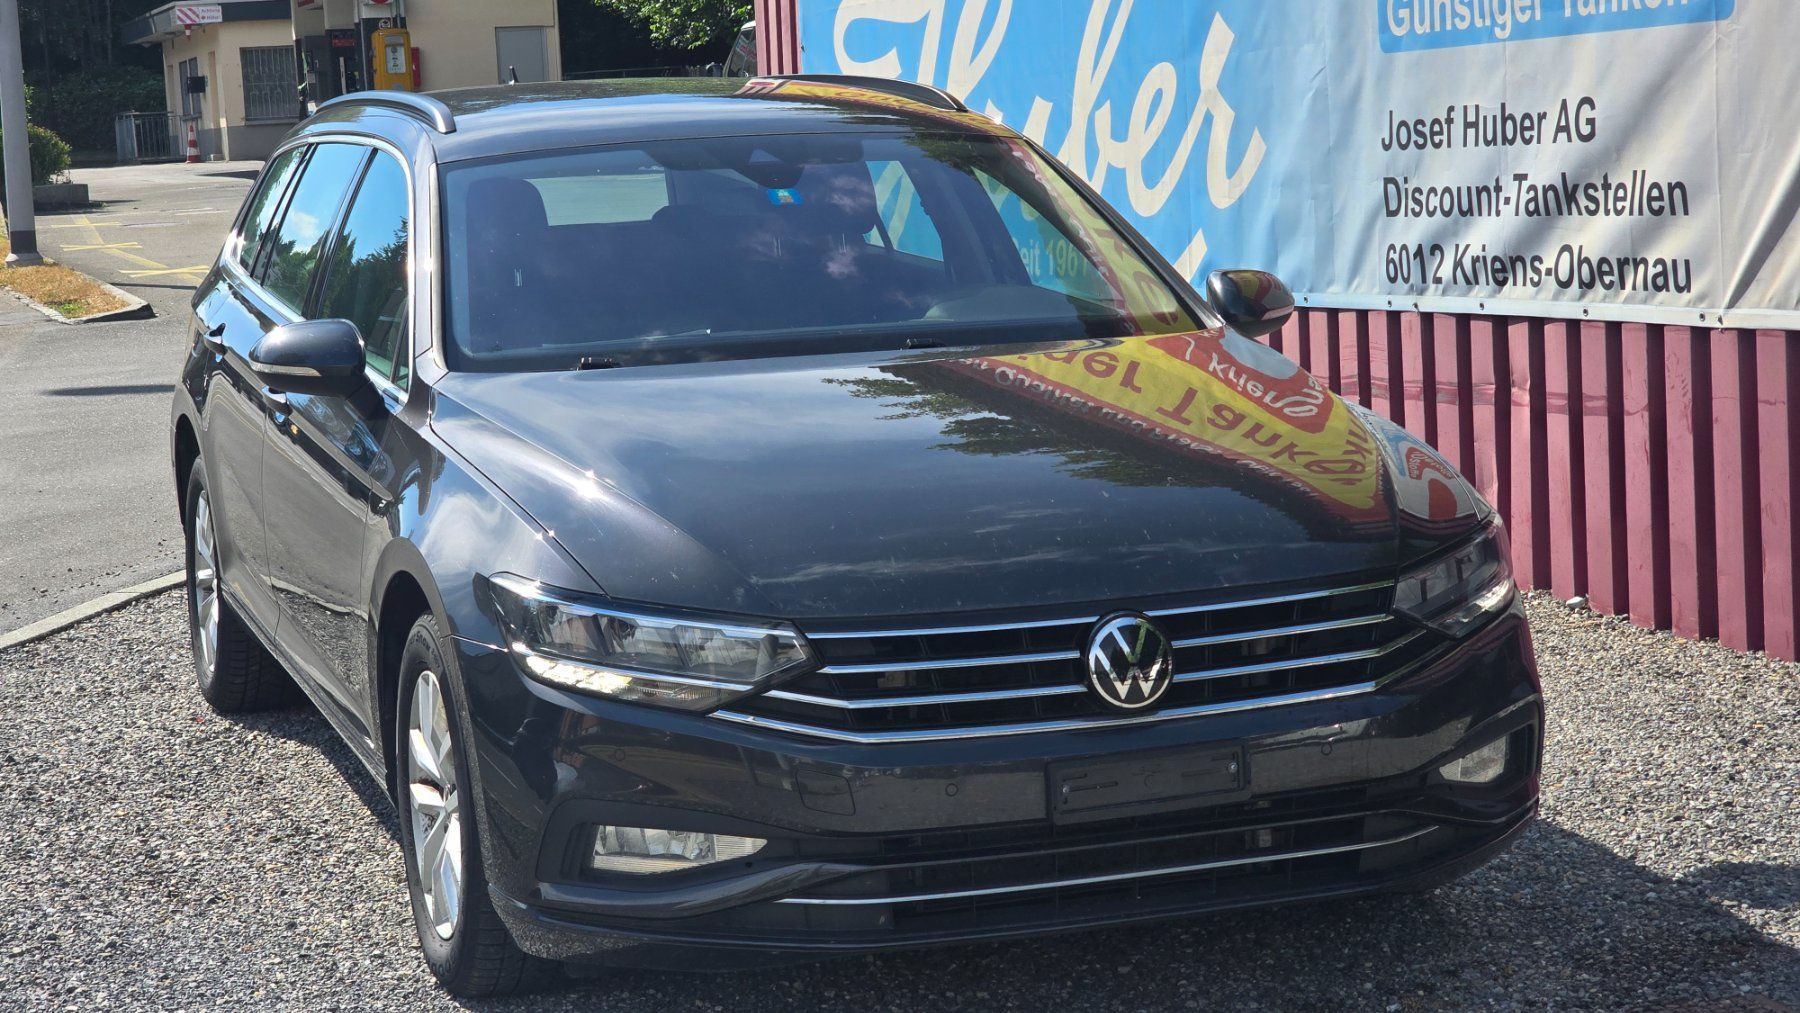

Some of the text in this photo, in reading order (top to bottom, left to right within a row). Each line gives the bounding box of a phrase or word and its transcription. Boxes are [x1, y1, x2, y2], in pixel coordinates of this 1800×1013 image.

[1381, 96, 1596, 151] Josef Huber AG
[1383, 170, 1690, 218] Discount-Tankstellen
[1014, 238, 1041, 277] eit
[1385, 243, 1692, 294] 6012 Kriens-Obernau
